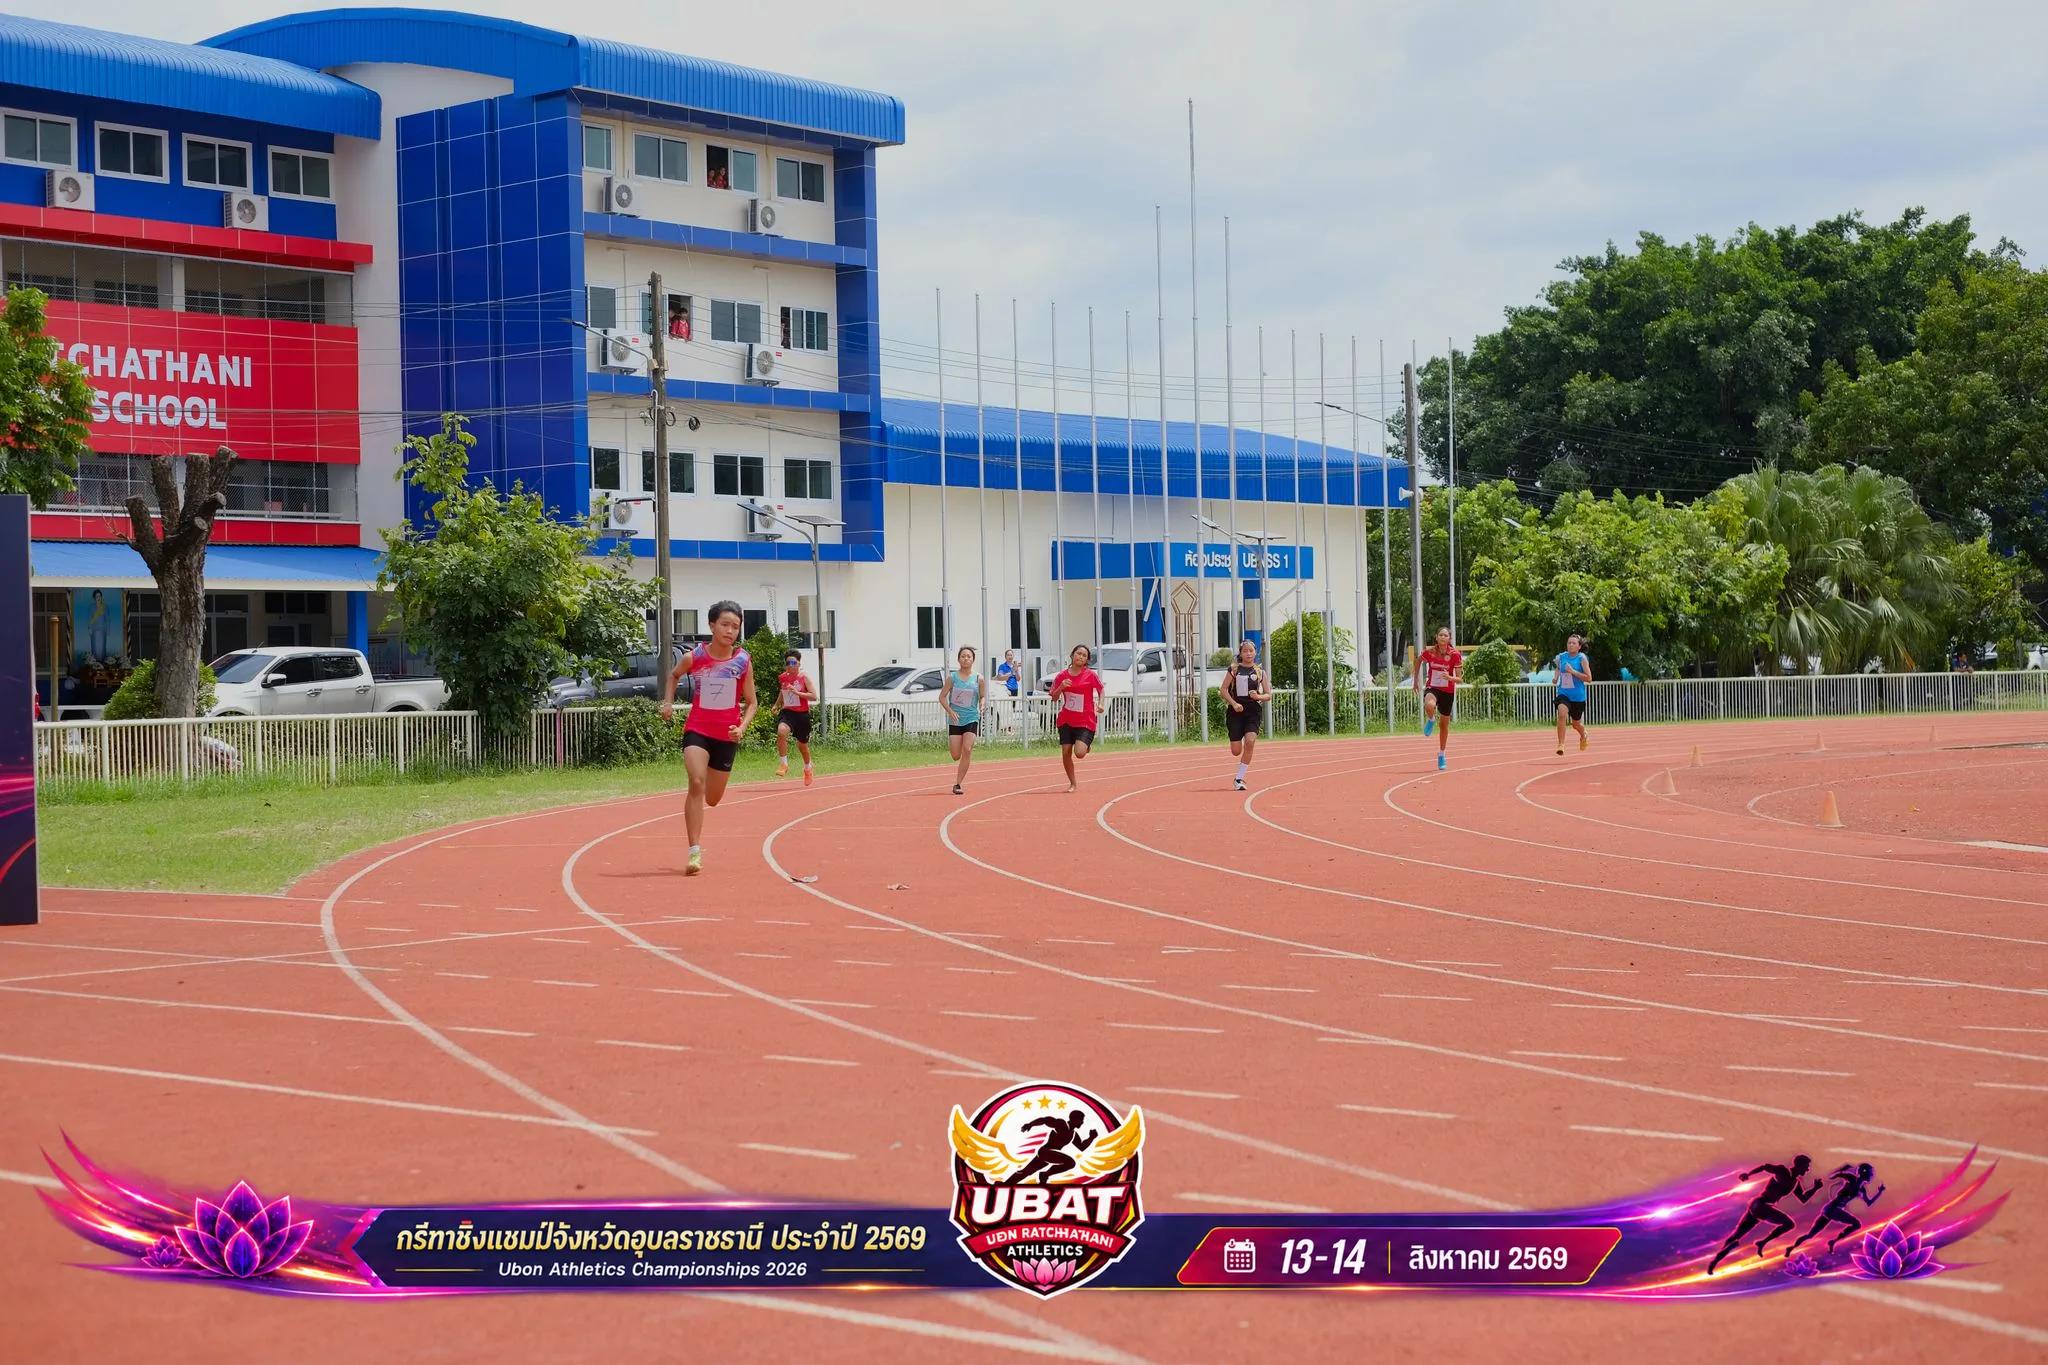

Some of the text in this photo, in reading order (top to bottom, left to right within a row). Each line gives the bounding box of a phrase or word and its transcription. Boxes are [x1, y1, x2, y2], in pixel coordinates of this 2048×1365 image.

[92, 390, 228, 430] SCHOOL
[1242, 552, 1281, 569] UBSS
[1283, 554, 1289, 569] 1
[709, 683, 725, 702] 7
